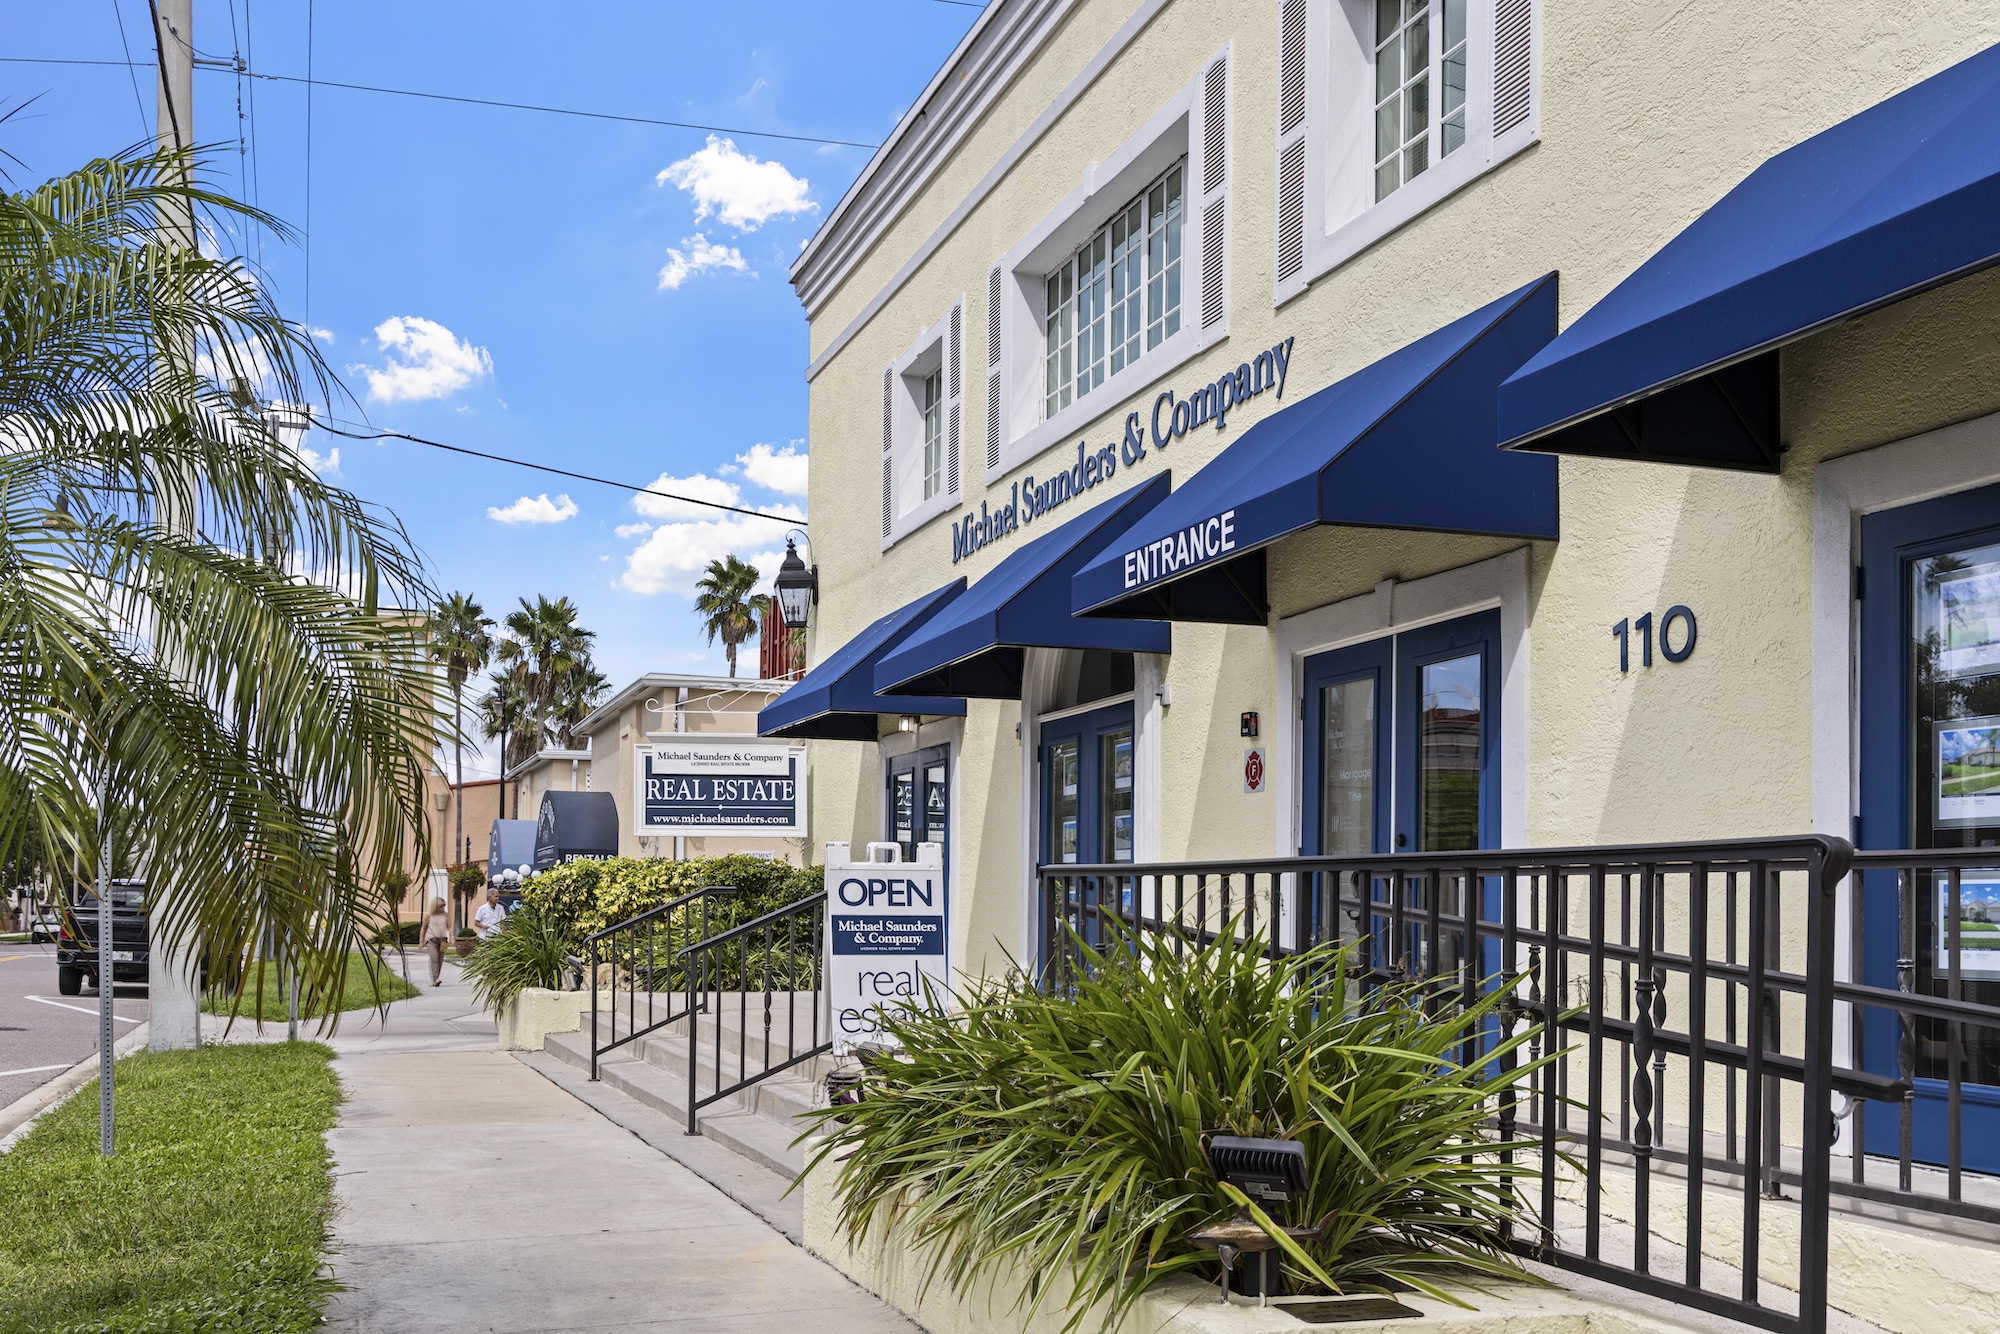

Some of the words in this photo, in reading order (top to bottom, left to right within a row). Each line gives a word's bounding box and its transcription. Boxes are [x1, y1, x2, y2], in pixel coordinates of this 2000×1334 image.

[951, 482, 1018, 563] Michael
[1021, 441, 1116, 523] Saunders
[1121, 412, 1146, 467] &
[1151, 336, 1295, 449] Company
[1124, 510, 1235, 589] ENTRANCE
[1612, 604, 1697, 672] 110
[657, 751, 691, 761] Michael
[693, 752, 731, 761] Saunders
[733, 753, 742, 761] &
[744, 752, 784, 763] Company
[646, 778, 707, 800] REAL
[712, 779, 795, 801] ESTATE
[652, 813, 789, 824] www.michaelsaunders.com
[838, 878, 932, 907] OPEN
[838, 920, 884, 932] Michael
[885, 920, 937, 932] Saunders
[853, 932, 866, 944] &
[858, 960, 919, 997] real
